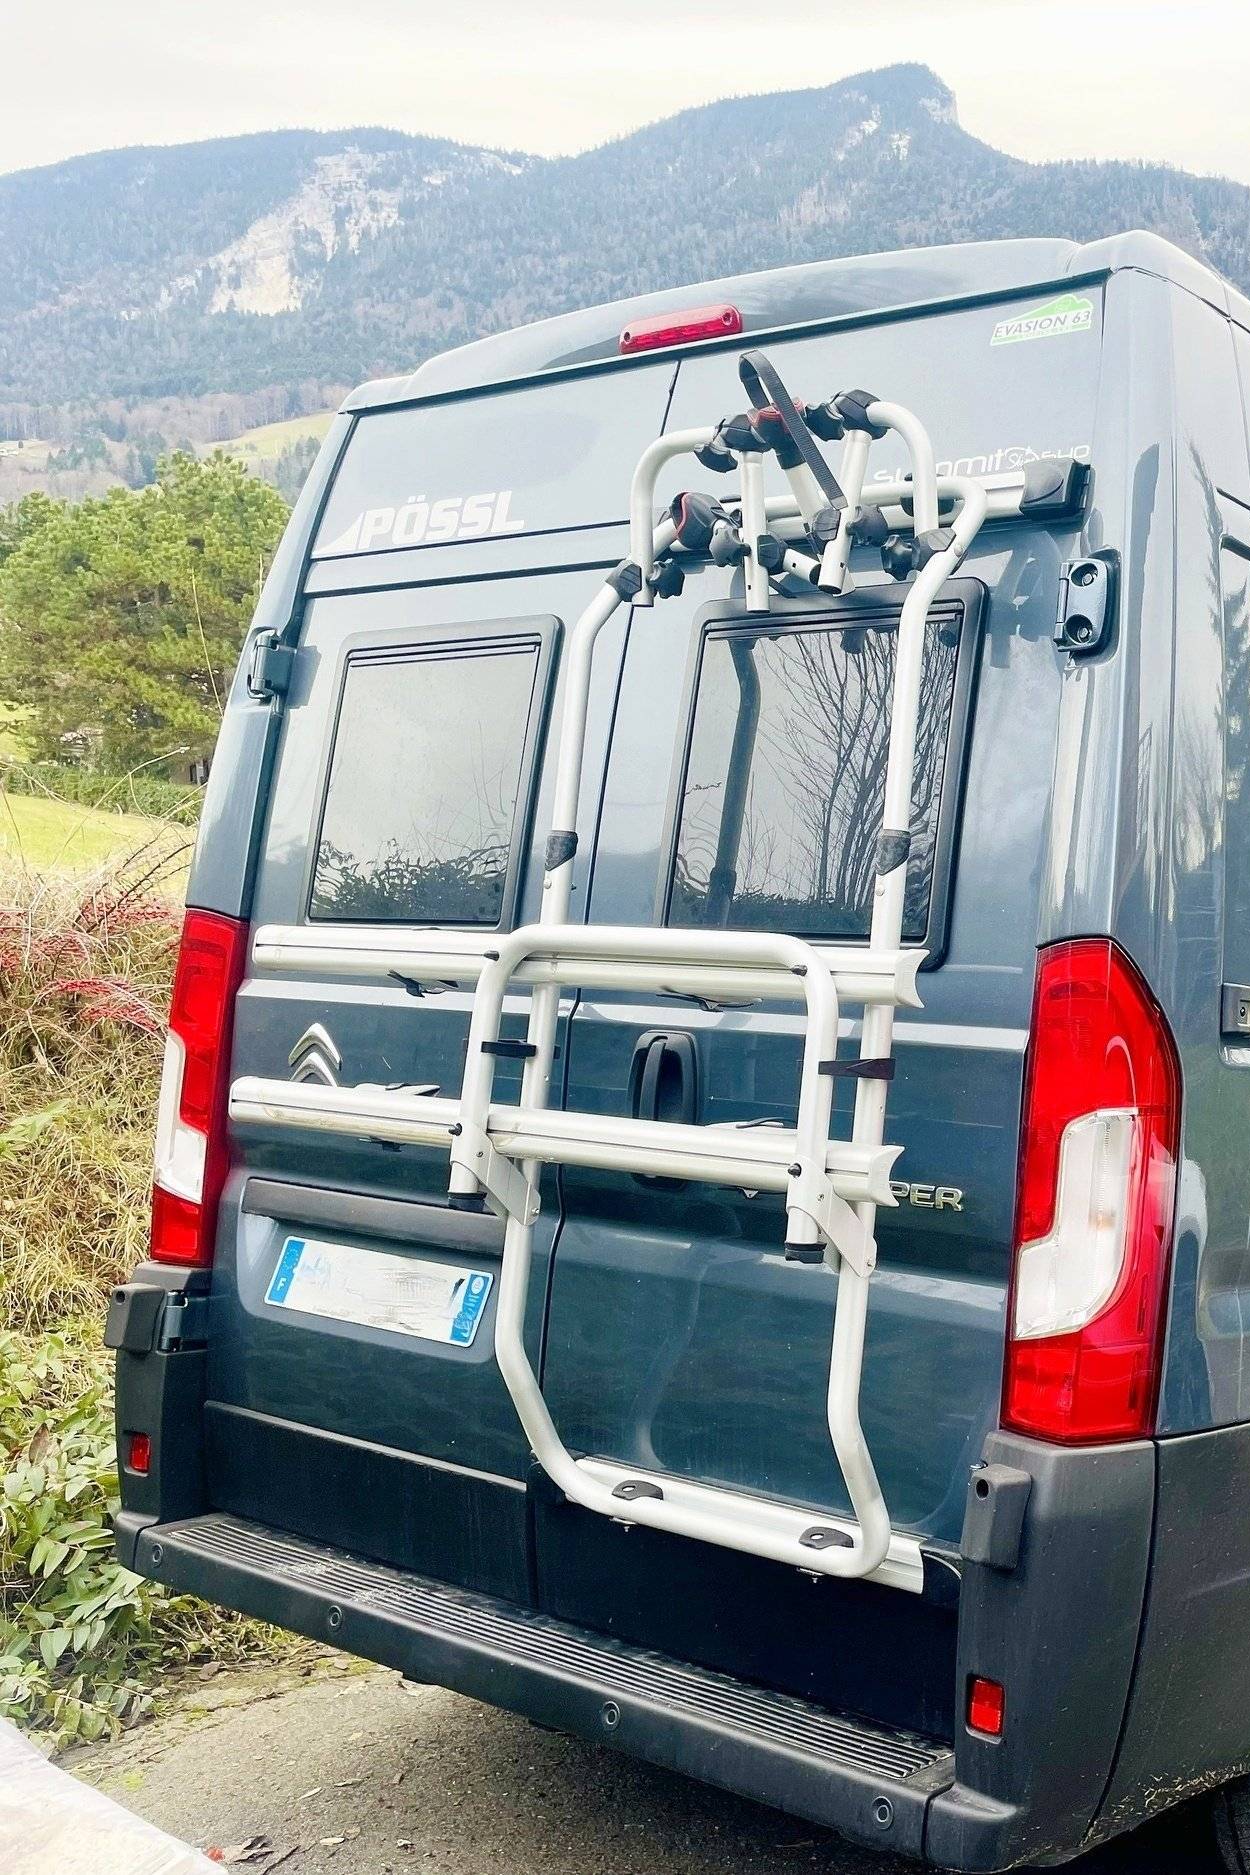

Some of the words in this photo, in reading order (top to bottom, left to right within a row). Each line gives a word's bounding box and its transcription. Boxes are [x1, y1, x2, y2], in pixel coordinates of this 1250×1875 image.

[994, 314, 1068, 338] EVASION
[1072, 310, 1090, 324] 63
[358, 490, 525, 549] PÖSSL
[277, 1277, 287, 1291] F
